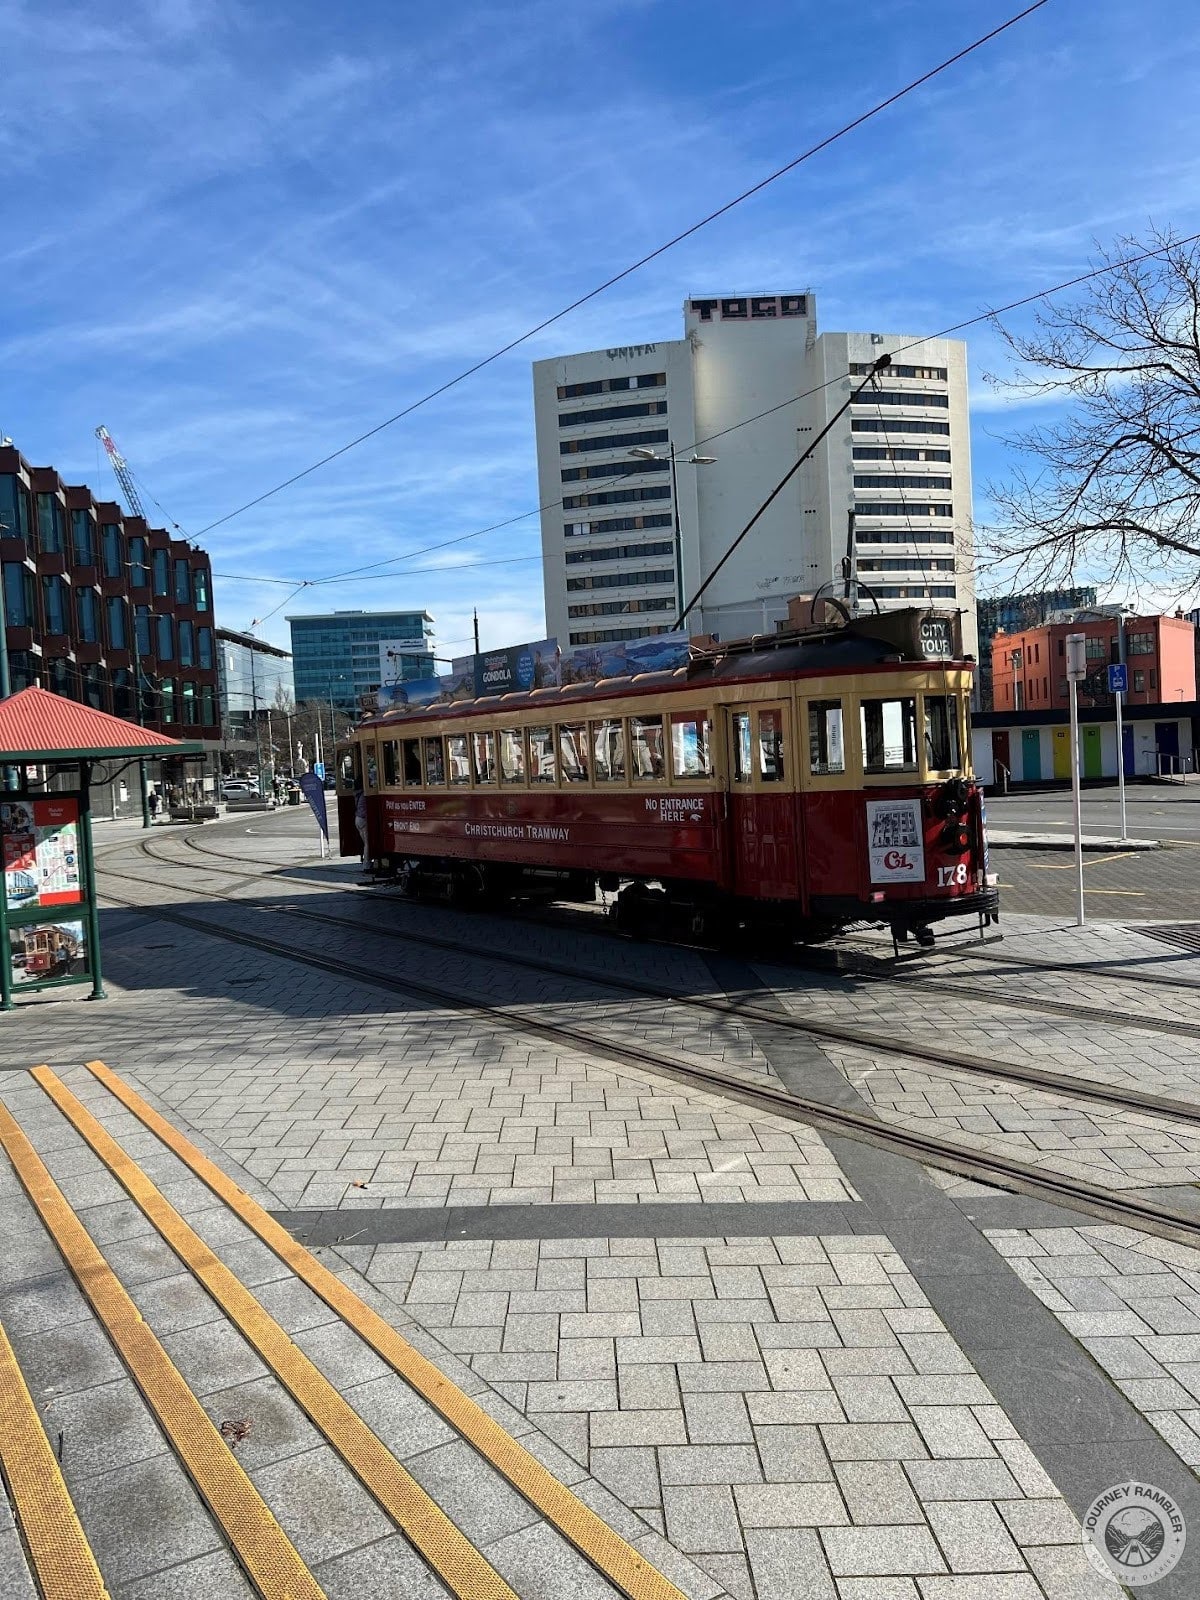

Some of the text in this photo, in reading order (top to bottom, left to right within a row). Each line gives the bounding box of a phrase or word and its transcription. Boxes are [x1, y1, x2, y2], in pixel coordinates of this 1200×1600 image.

[921, 623, 946, 637] CITY
[920, 639, 950, 653] TOUR
[482, 668, 512, 683] GONDOLA
[409, 800, 426, 811] ENTER
[660, 798, 704, 810] ENTRANCE
[660, 809, 685, 822] HERE
[464, 822, 570, 841] CHRISTCHURCH TRAMWAY
[937, 863, 968, 887] 178
